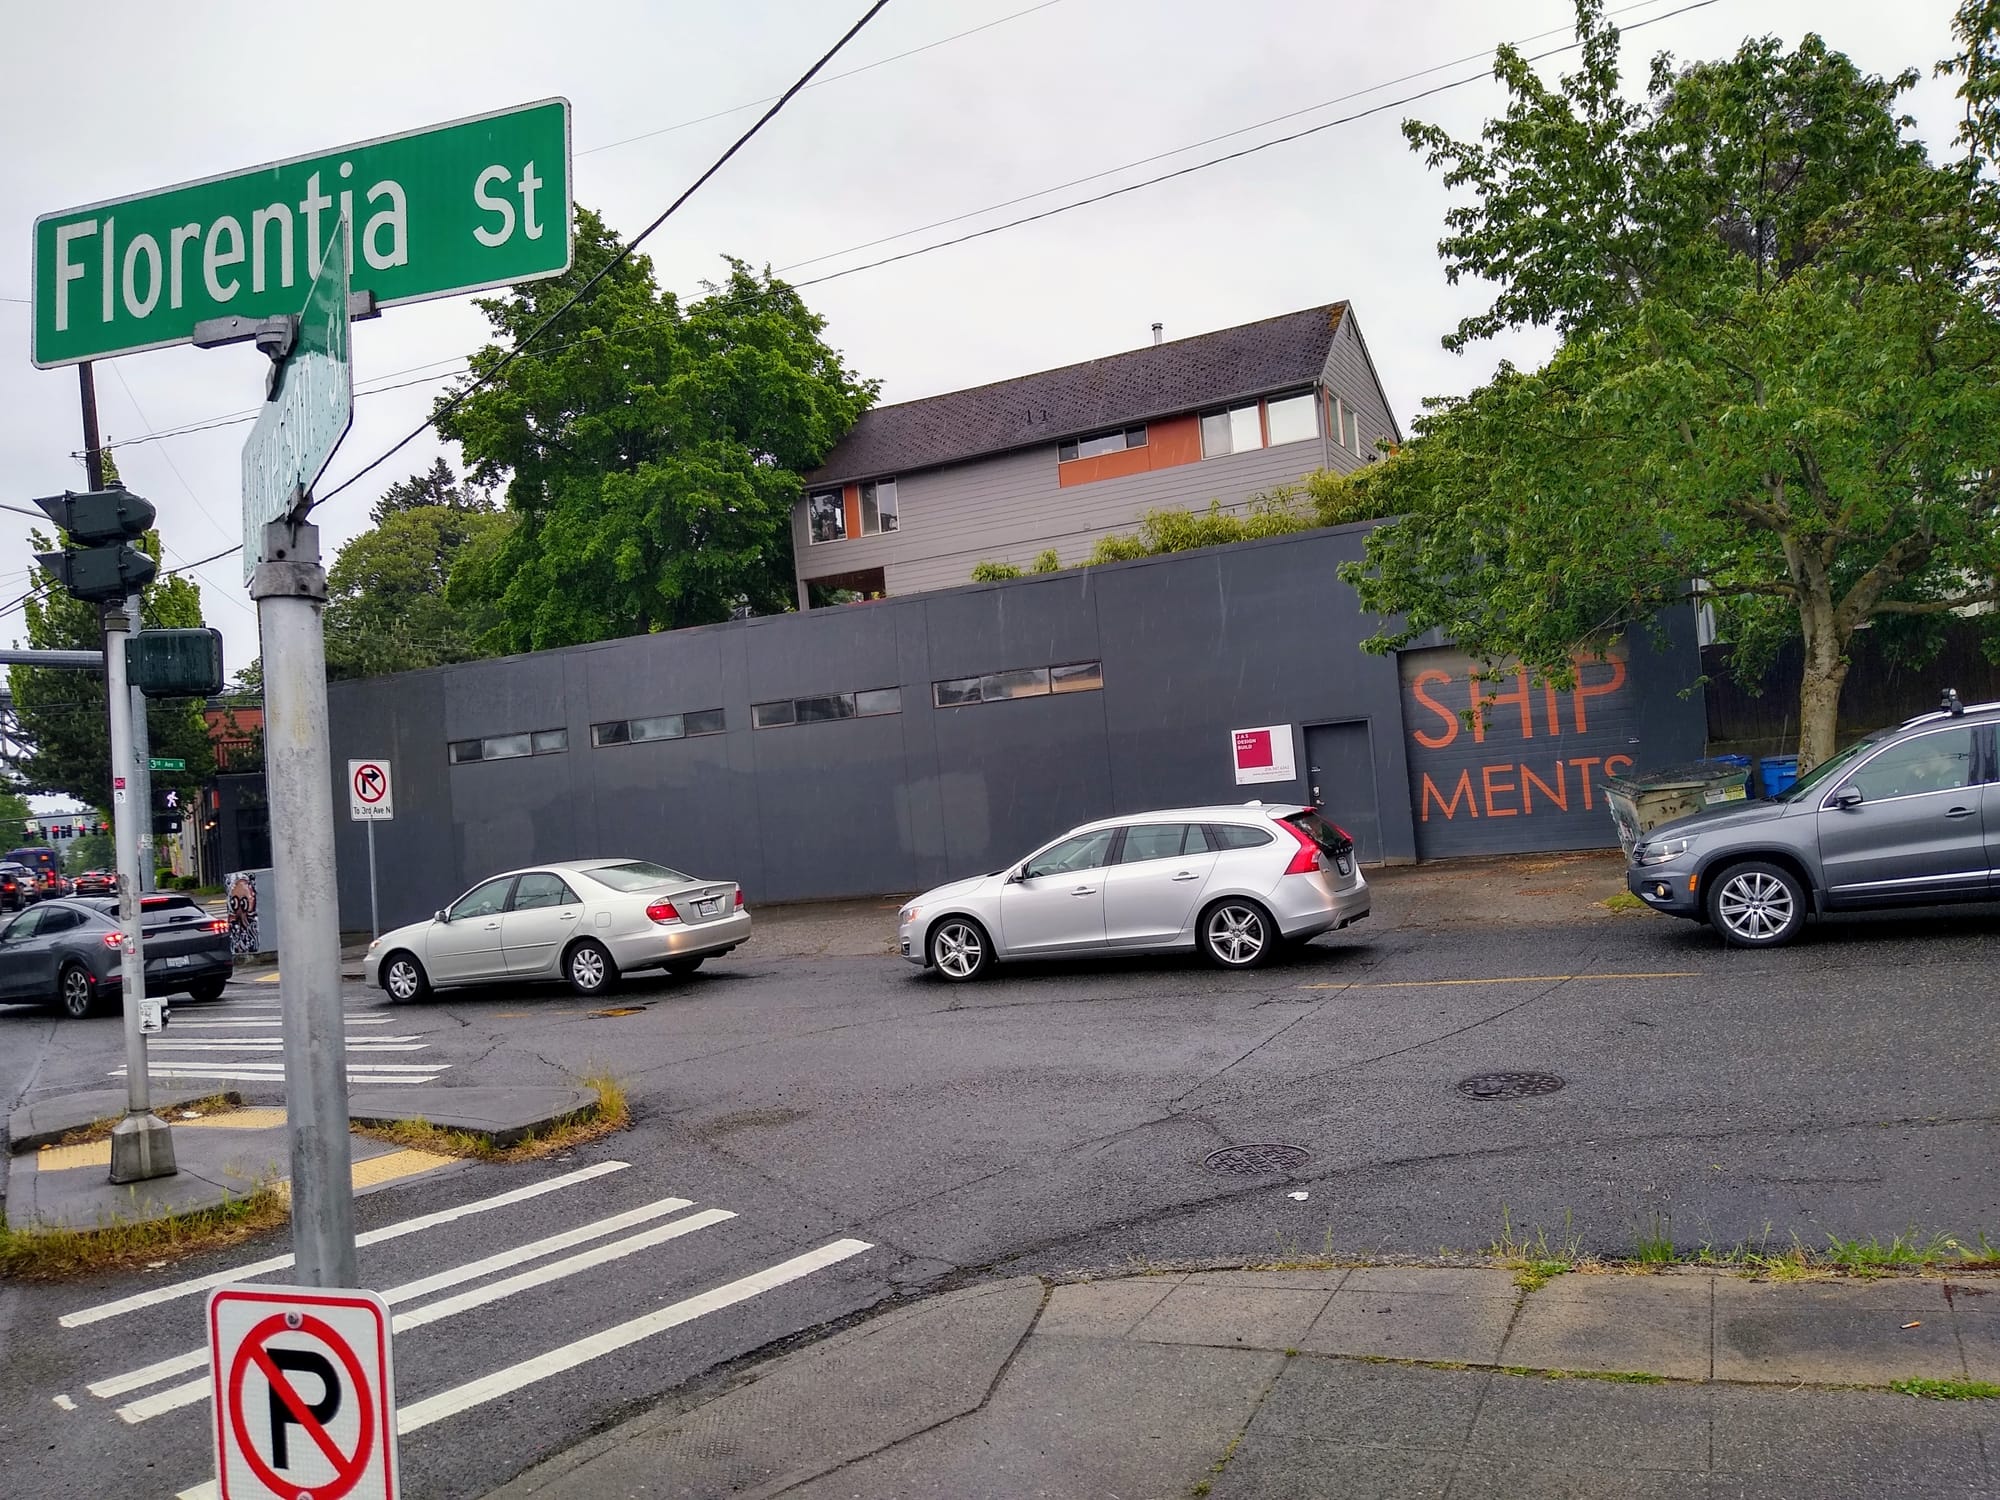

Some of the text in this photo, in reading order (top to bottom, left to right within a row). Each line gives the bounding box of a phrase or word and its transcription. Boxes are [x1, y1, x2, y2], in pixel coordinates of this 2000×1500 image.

[55, 160, 545, 331] Florentia St
[1412, 652, 1626, 749] SHIP
[353, 806, 360, 815] To
[361, 806, 371, 815] 3rd
[373, 806, 384, 814] Ave
